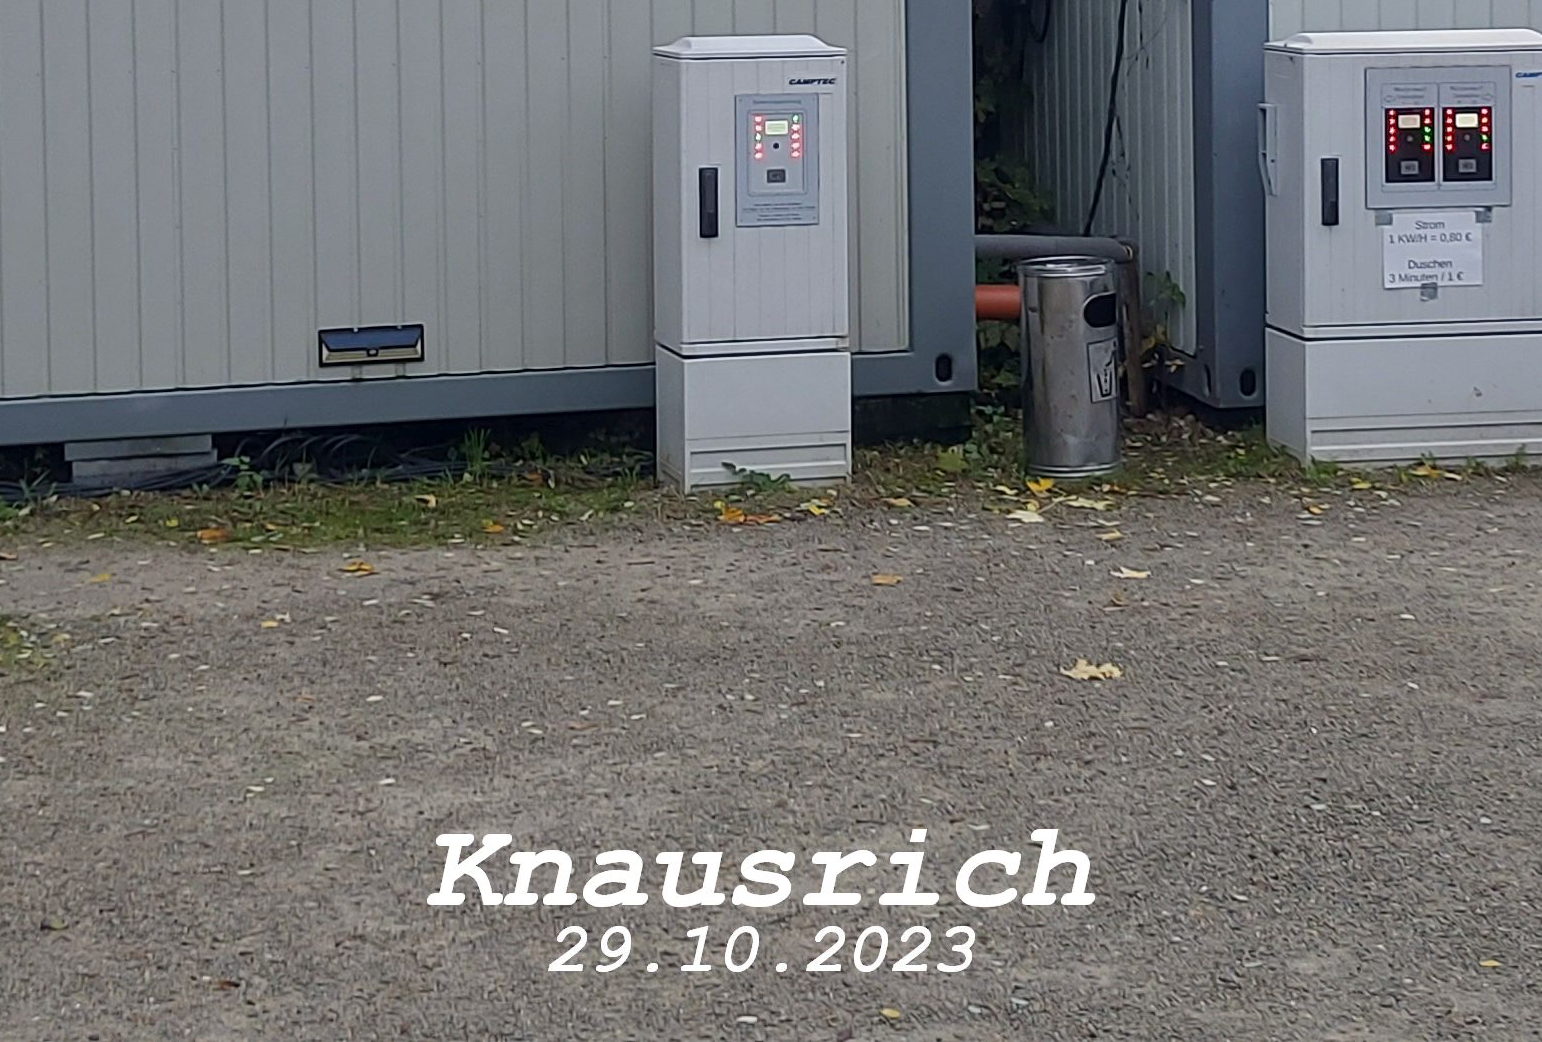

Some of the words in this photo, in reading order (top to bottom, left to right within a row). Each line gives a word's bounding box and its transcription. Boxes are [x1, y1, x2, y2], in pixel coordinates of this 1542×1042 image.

[1415, 220, 1445, 230] Strom
[1408, 259, 1452, 269] Duschen
[1389, 274, 1396, 283] 3
[1399, 272, 1438, 282] Minuten
